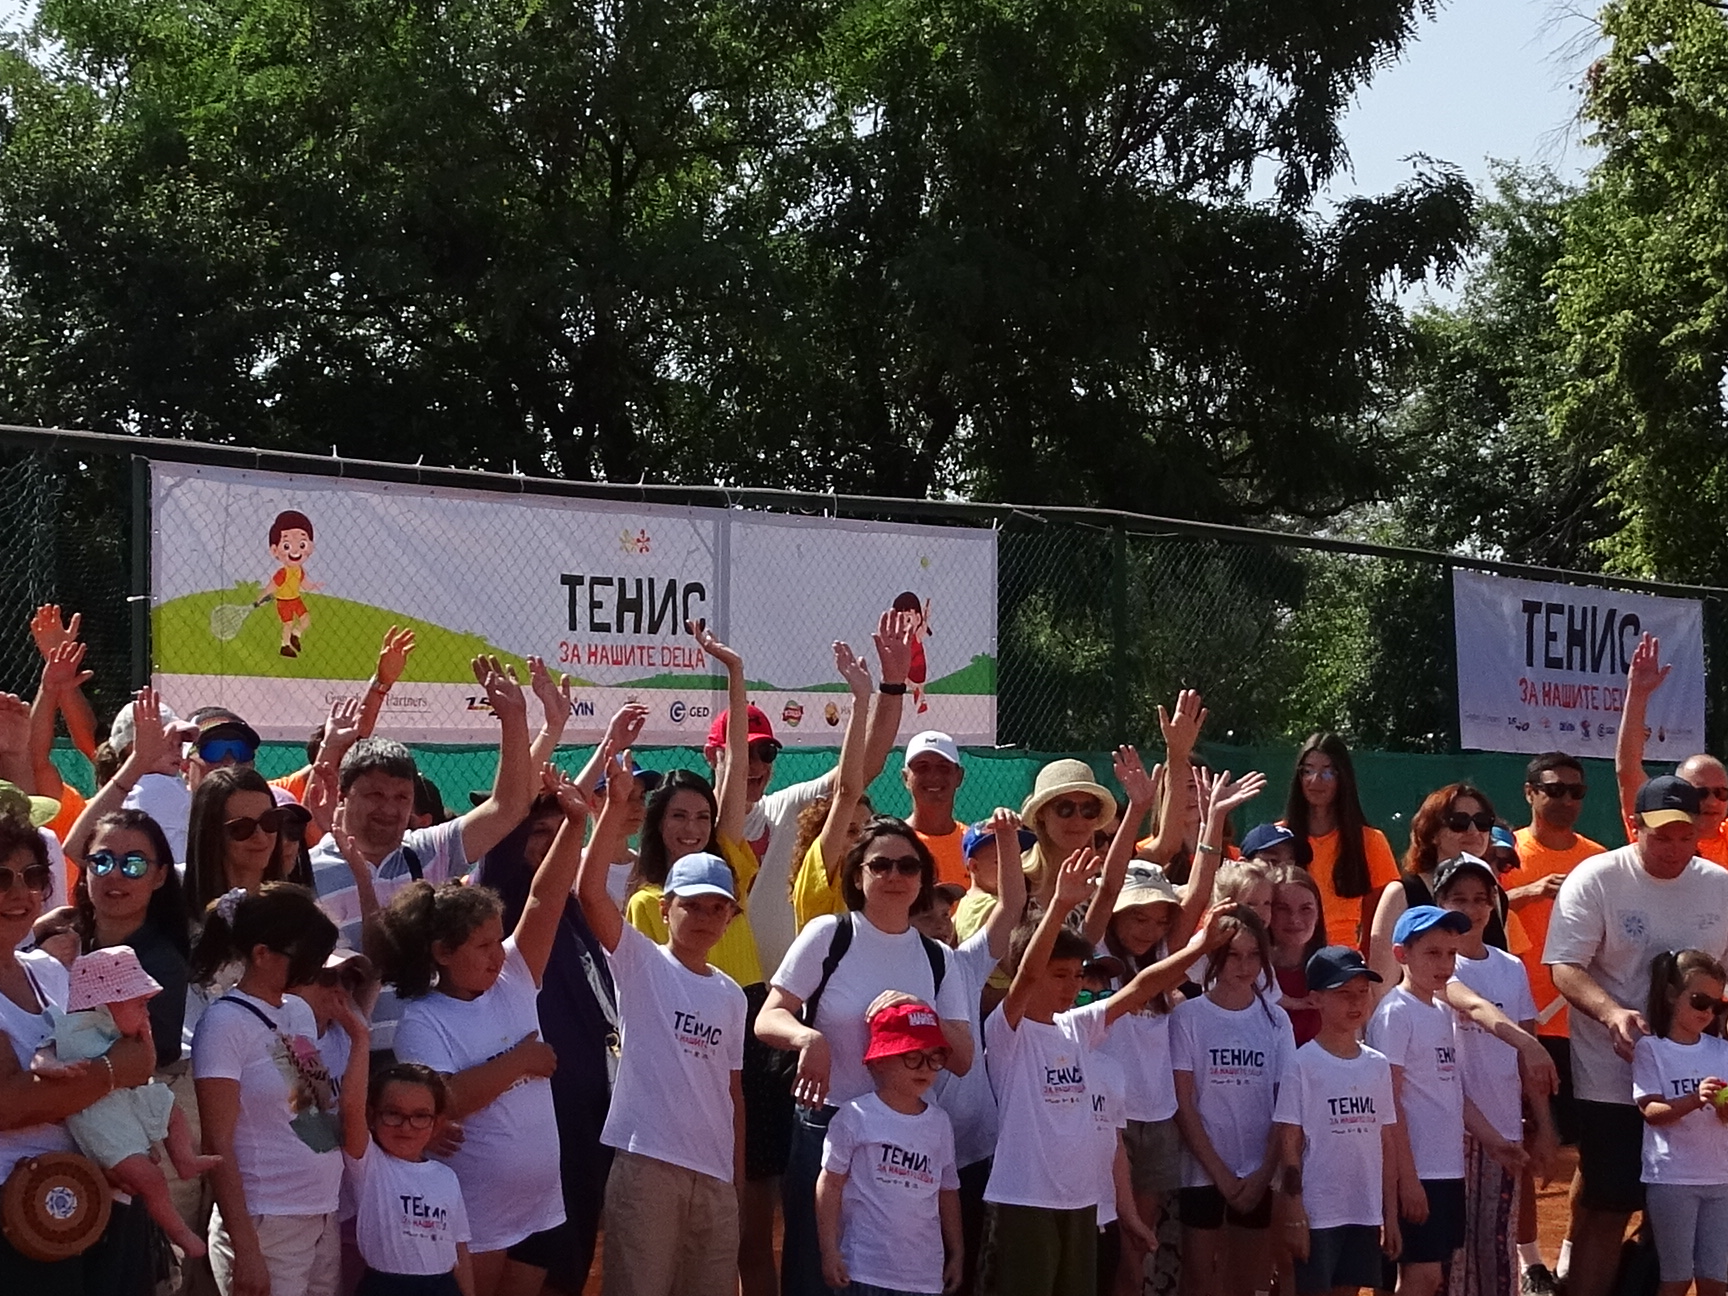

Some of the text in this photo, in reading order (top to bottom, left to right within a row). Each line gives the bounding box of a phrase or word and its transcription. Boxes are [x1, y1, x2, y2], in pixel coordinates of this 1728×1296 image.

[560, 573, 706, 636] ТЕНИС
[1521, 599, 1641, 675] ТЕНИС
[558, 640, 582, 665] ЗА
[586, 642, 656, 667] НАШИТЕ
[1518, 677, 1539, 707] ЗА
[1542, 681, 1599, 710] НАШИТЕ
[569, 700, 595, 717] VIN
[689, 705, 710, 718] GED
[1209, 1048, 1265, 1068] ТЕНИС
[1044, 1066, 1083, 1086] ЕНИС
[1670, 1078, 1701, 1096] ТЕН
[881, 1143, 932, 1175] ТЕНИ
